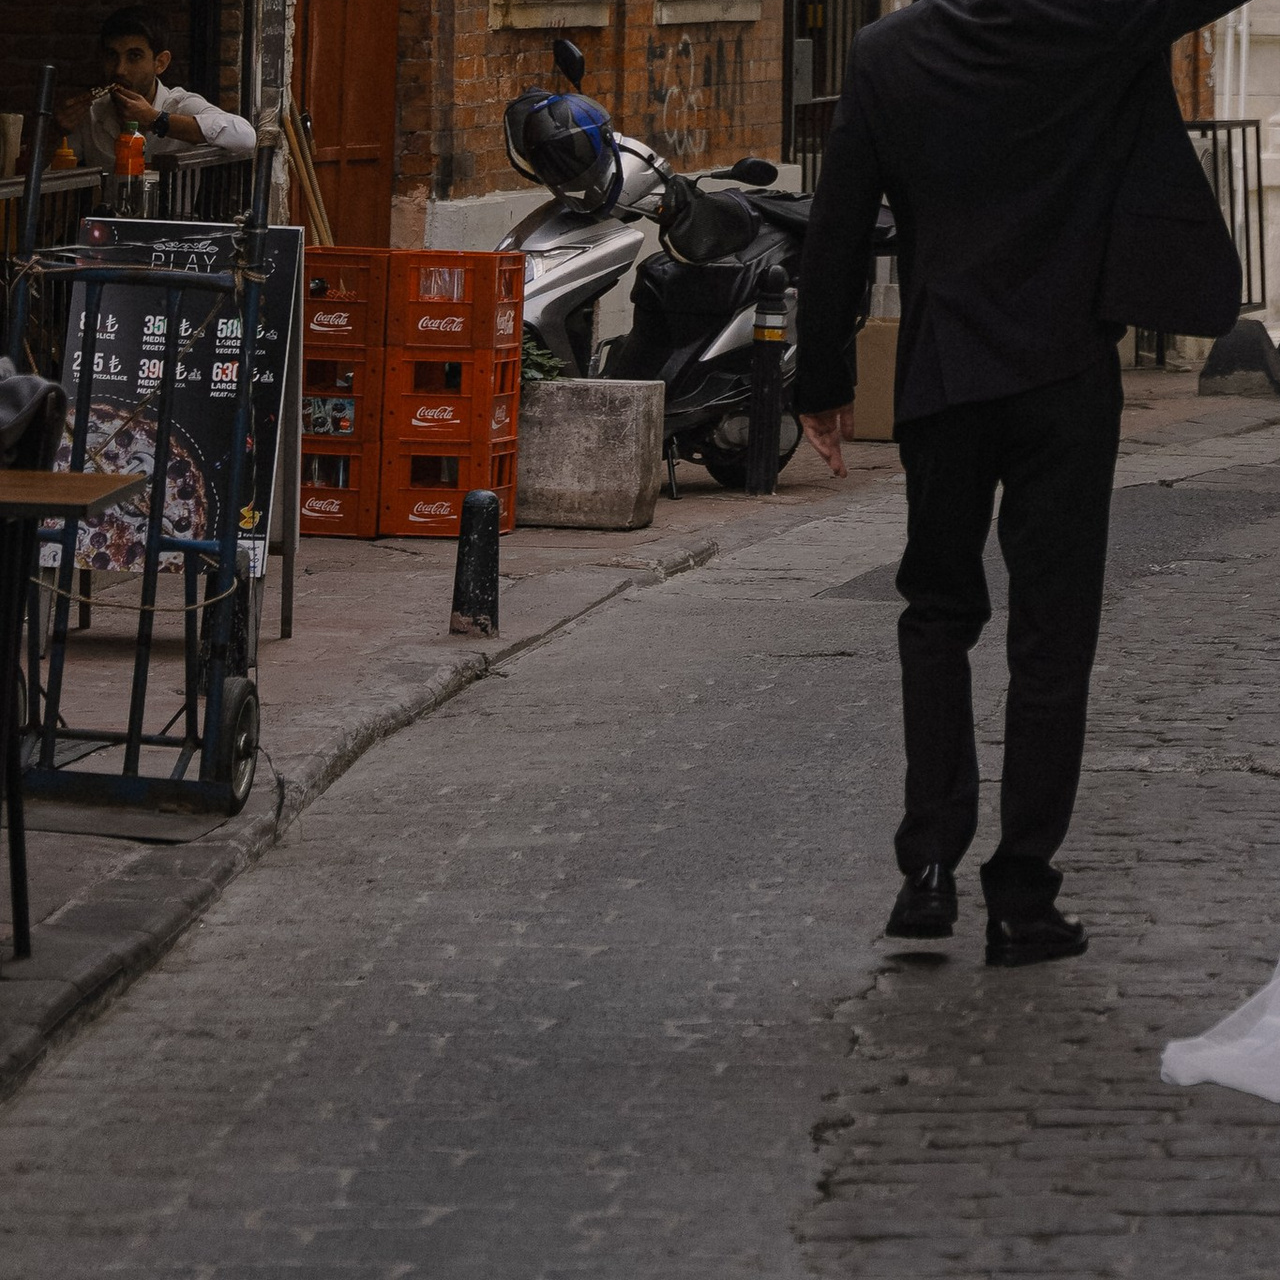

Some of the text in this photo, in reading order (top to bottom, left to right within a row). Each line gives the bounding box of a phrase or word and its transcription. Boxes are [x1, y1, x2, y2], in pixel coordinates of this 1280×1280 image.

[151, 252, 217, 273] PLAY
[417, 315, 466, 332] Coca-Cola
[215, 338, 242, 347] LARGE
[72, 351, 104, 372] 25
[210, 382, 238, 390] LARGE
